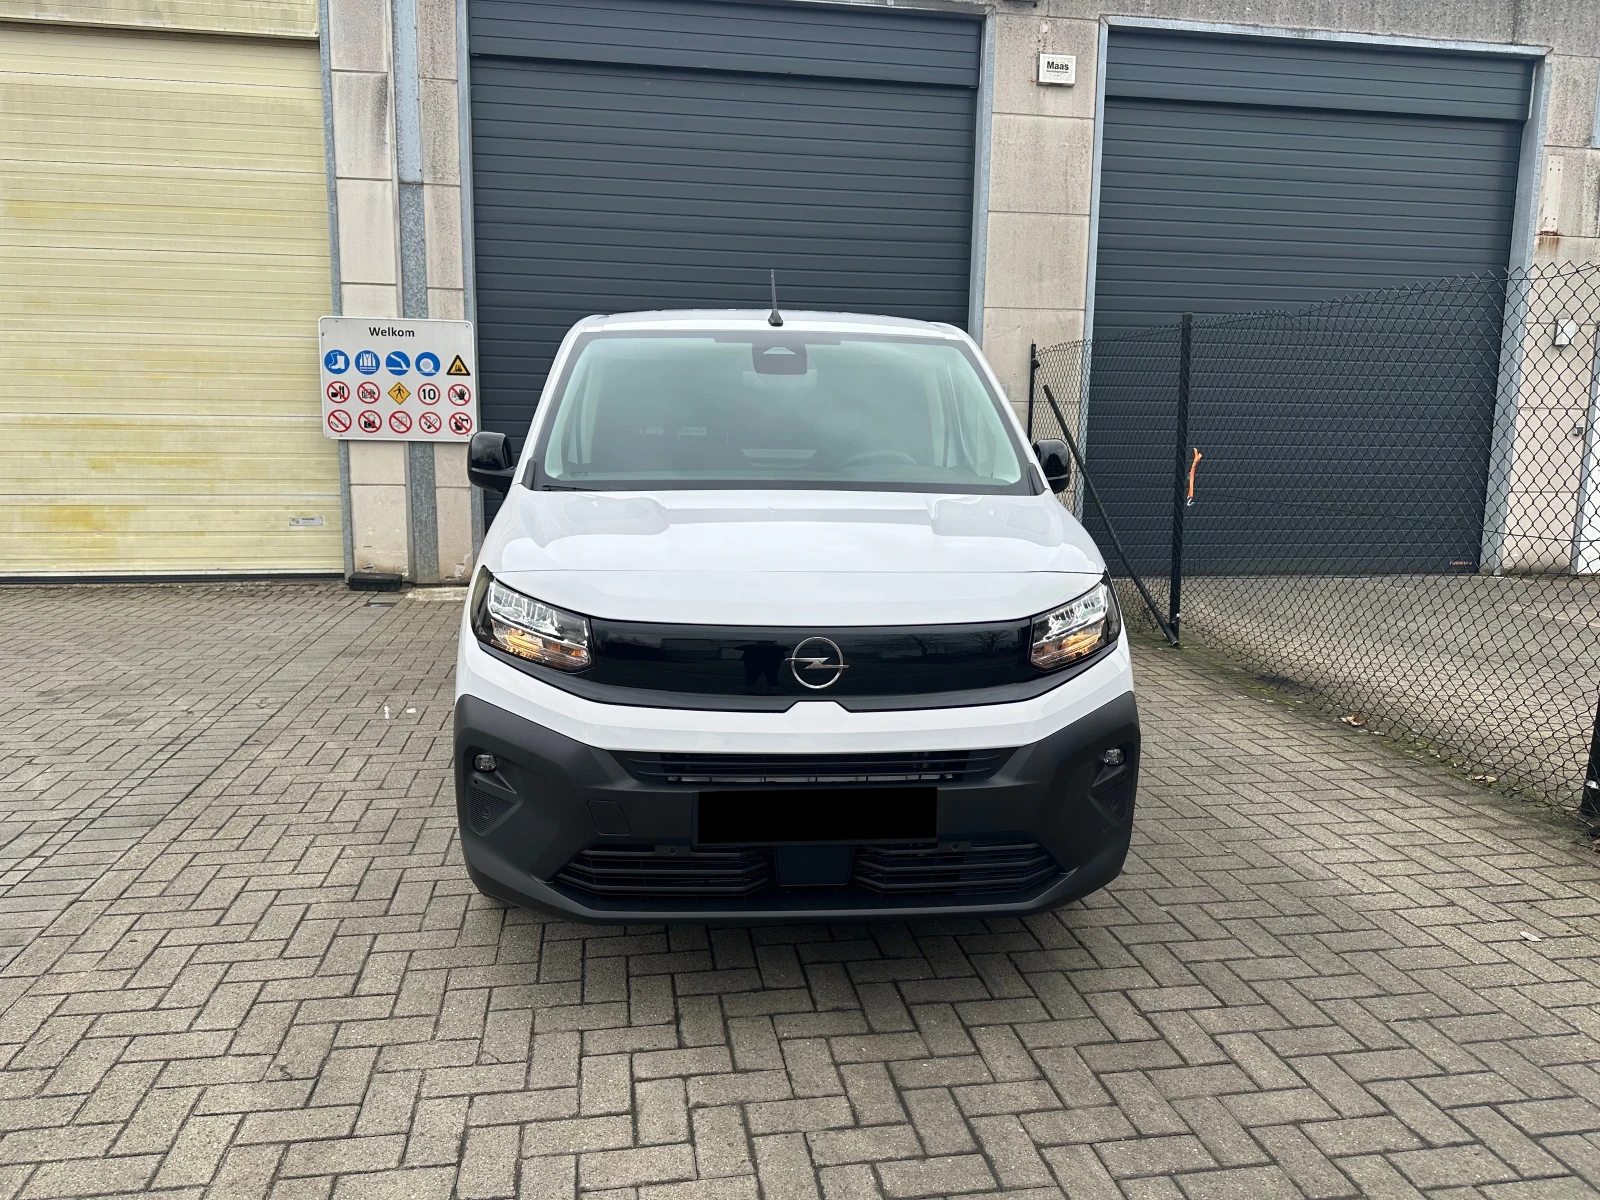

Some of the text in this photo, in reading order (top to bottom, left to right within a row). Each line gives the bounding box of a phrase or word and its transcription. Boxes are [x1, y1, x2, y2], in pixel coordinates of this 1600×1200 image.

[1046, 61, 1069, 71] Maas
[368, 326, 415, 338] Welkom
[421, 388, 437, 400] 10
